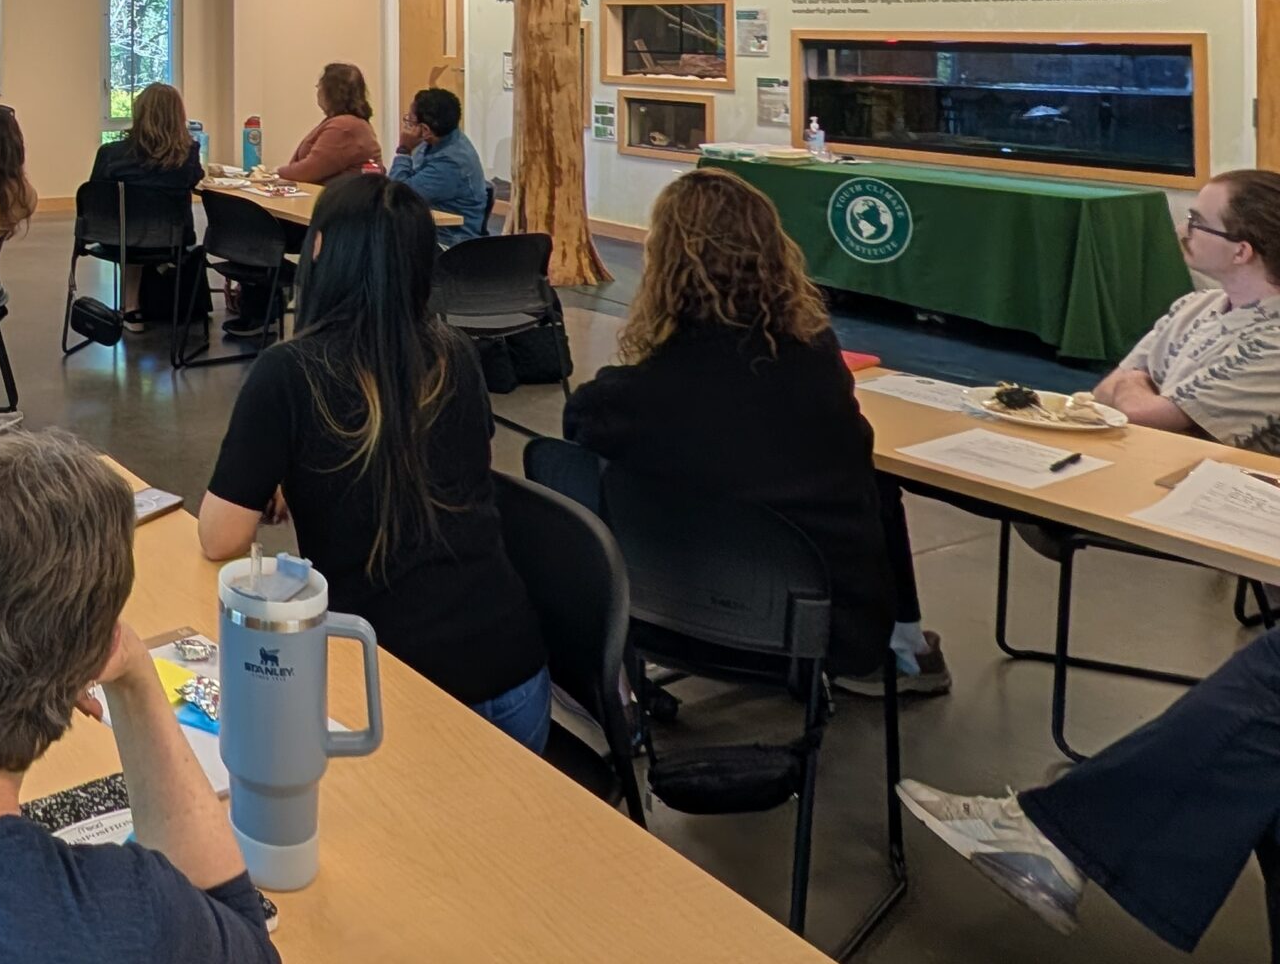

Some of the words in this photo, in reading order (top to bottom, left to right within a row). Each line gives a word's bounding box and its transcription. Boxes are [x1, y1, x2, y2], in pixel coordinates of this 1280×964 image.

[835, 184, 863, 209] YOUTH
[865, 184, 906, 219] CLIMATE
[844, 236, 898, 256] INSTITUTE
[244, 661, 294, 677] STANLEY
